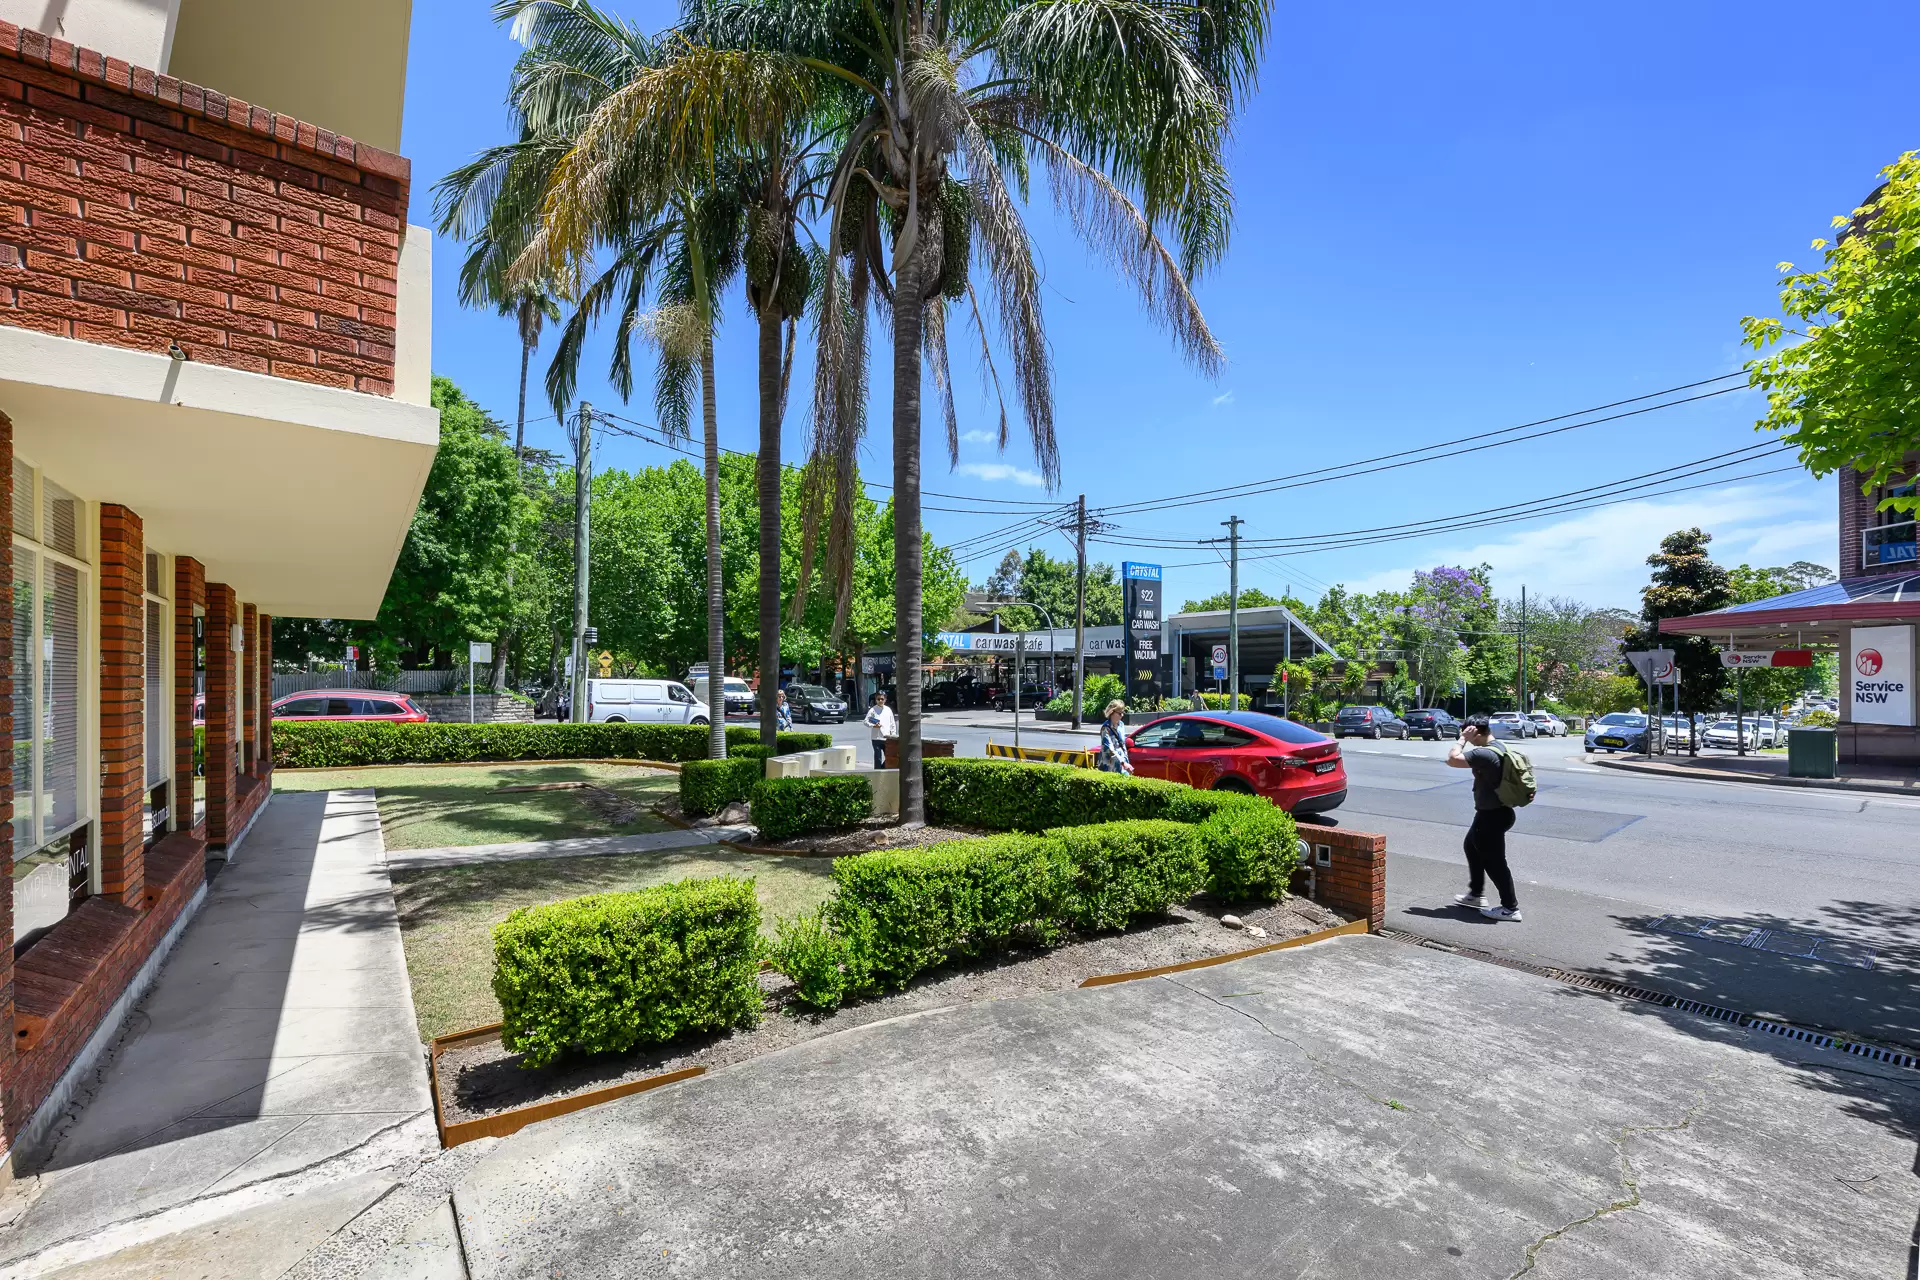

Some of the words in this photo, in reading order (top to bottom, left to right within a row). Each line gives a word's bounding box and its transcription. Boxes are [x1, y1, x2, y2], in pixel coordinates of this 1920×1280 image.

[1130, 565, 1159, 578] CRYSTAL
[1141, 590, 1154, 601] $22
[1138, 610, 1142, 618] 4
[1143, 610, 1154, 619] MIN
[1131, 620, 1144, 629] CAR
[1144, 620, 1160, 630] WASH
[975, 638, 993, 649] car
[1024, 638, 1043, 650] cafe
[1089, 640, 1104, 650] car
[1138, 640, 1153, 650] FREE
[1134, 650, 1157, 660] VACUUM
[1855, 681, 1904, 692] Service
[1855, 693, 1888, 704] NSW
